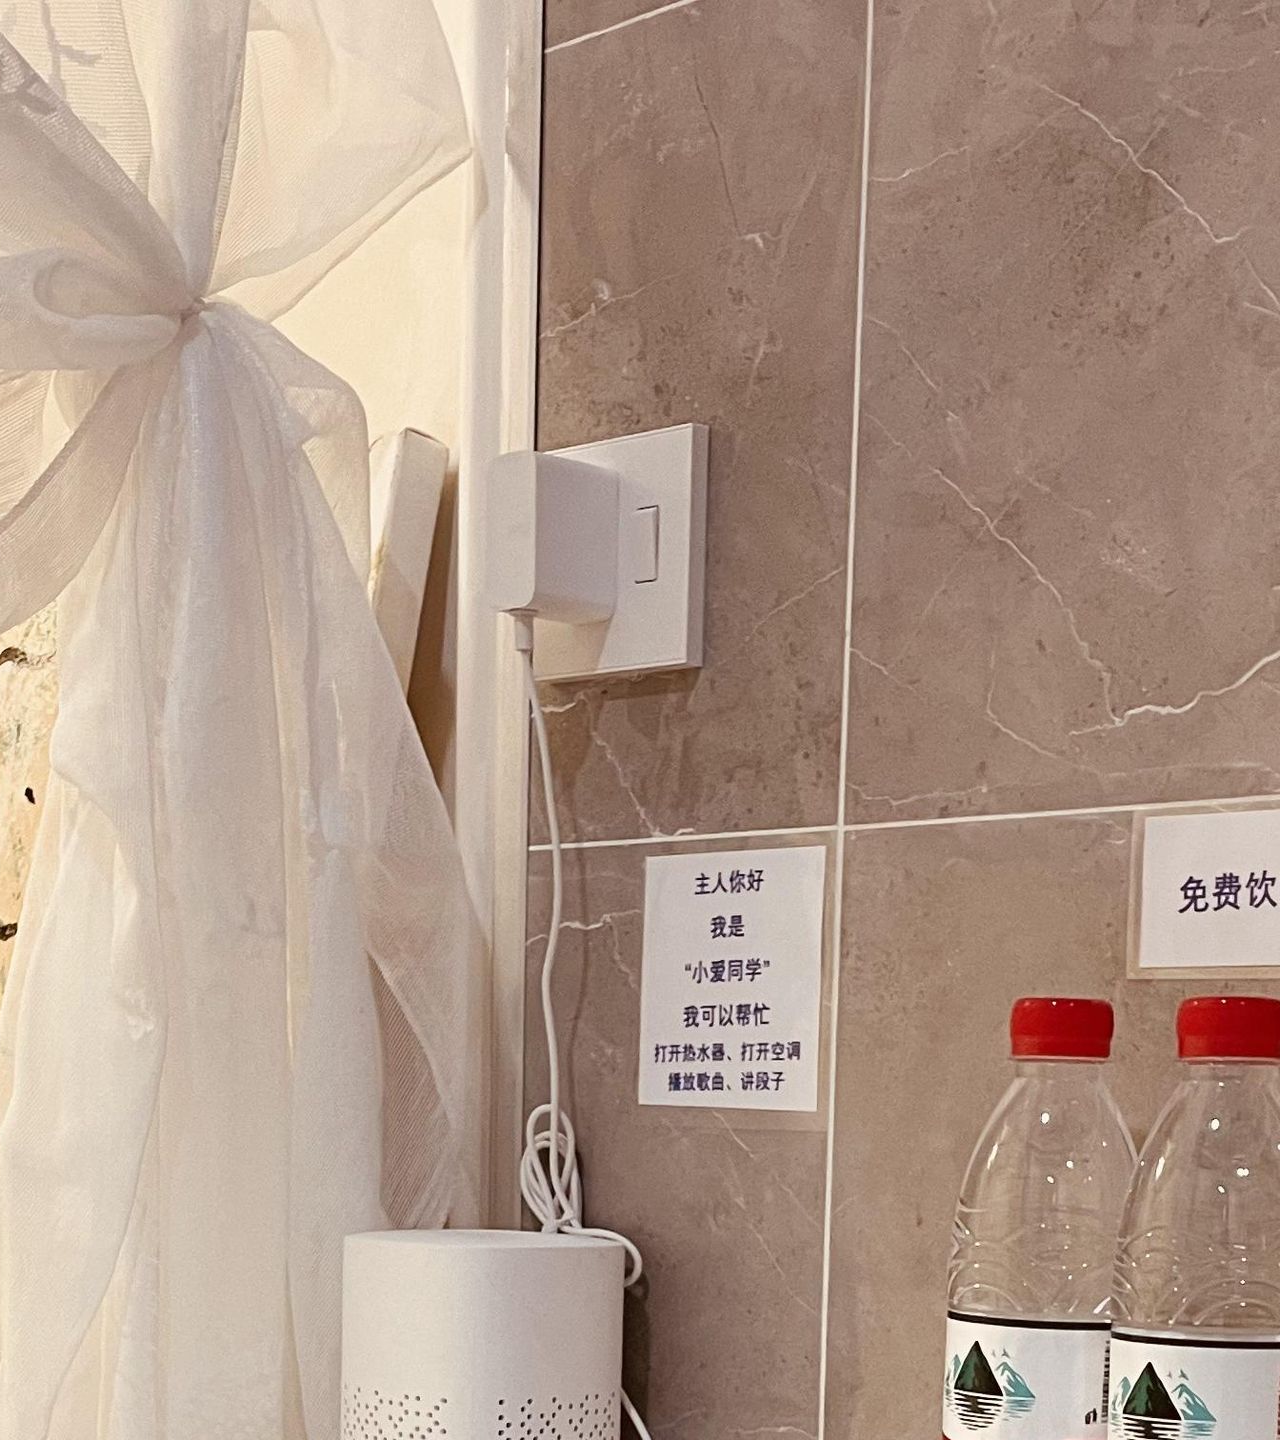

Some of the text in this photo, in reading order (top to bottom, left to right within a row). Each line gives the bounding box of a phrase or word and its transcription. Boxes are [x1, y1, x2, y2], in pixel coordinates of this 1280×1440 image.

[693, 868, 765, 896] 主人你好
[709, 914, 745, 940] 我是
[682, 1002, 771, 1029] 我可以帮忙
